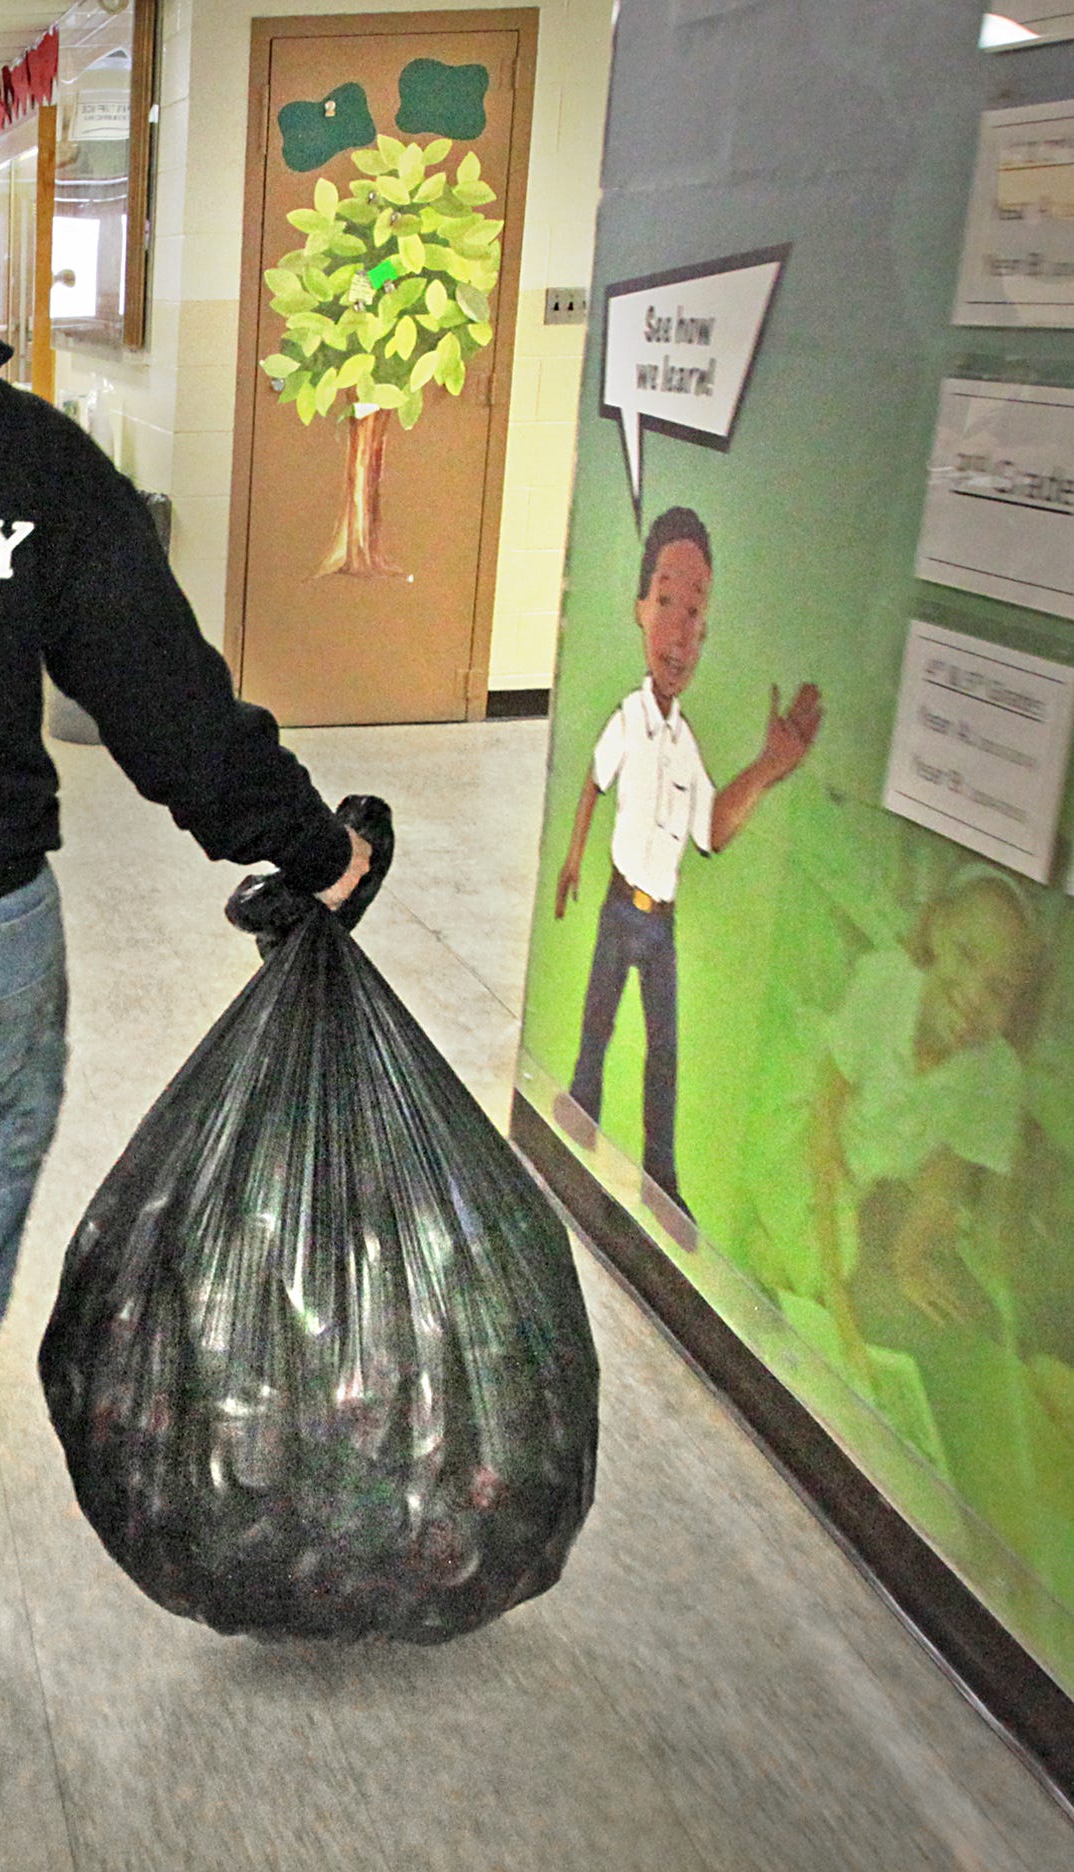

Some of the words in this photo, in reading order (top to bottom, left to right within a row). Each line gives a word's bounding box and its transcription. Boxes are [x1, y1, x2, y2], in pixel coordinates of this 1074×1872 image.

[324, 100, 336, 117] 2
[644, 305, 672, 342] See
[676, 305, 716, 346] how
[636, 363, 659, 390] we
